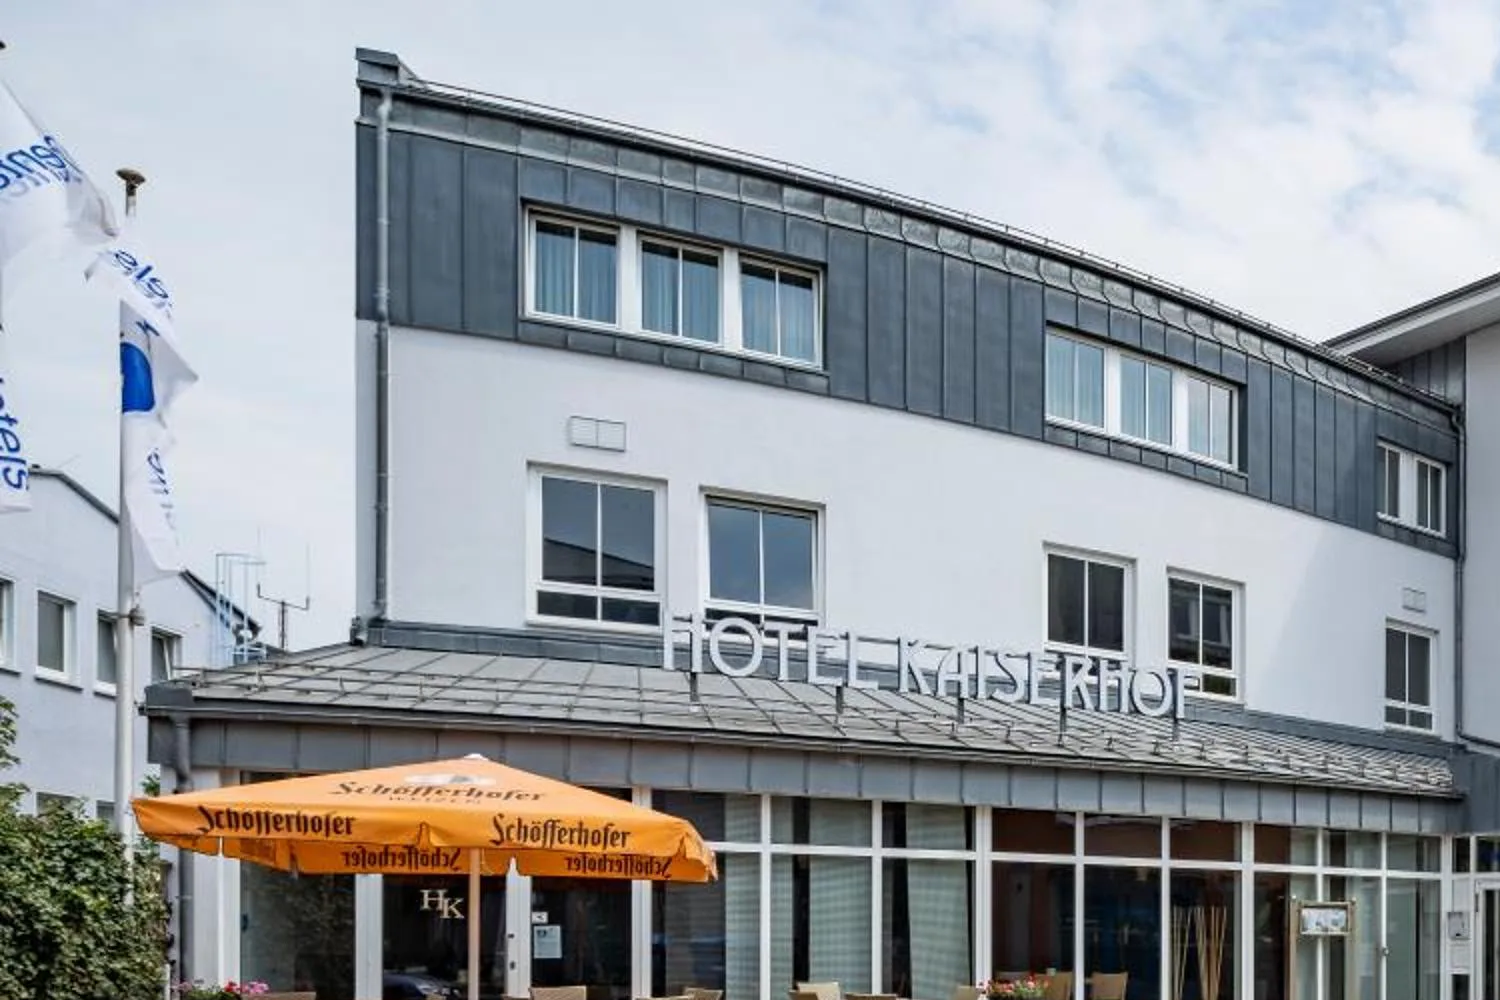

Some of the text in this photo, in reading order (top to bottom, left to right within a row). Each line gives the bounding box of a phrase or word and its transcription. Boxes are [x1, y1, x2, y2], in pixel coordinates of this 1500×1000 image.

[663, 604, 1200, 719] HOTEL KAISERHOF
[489, 813, 631, 848] Schöfferhofer
[420, 889, 464, 919] HK
